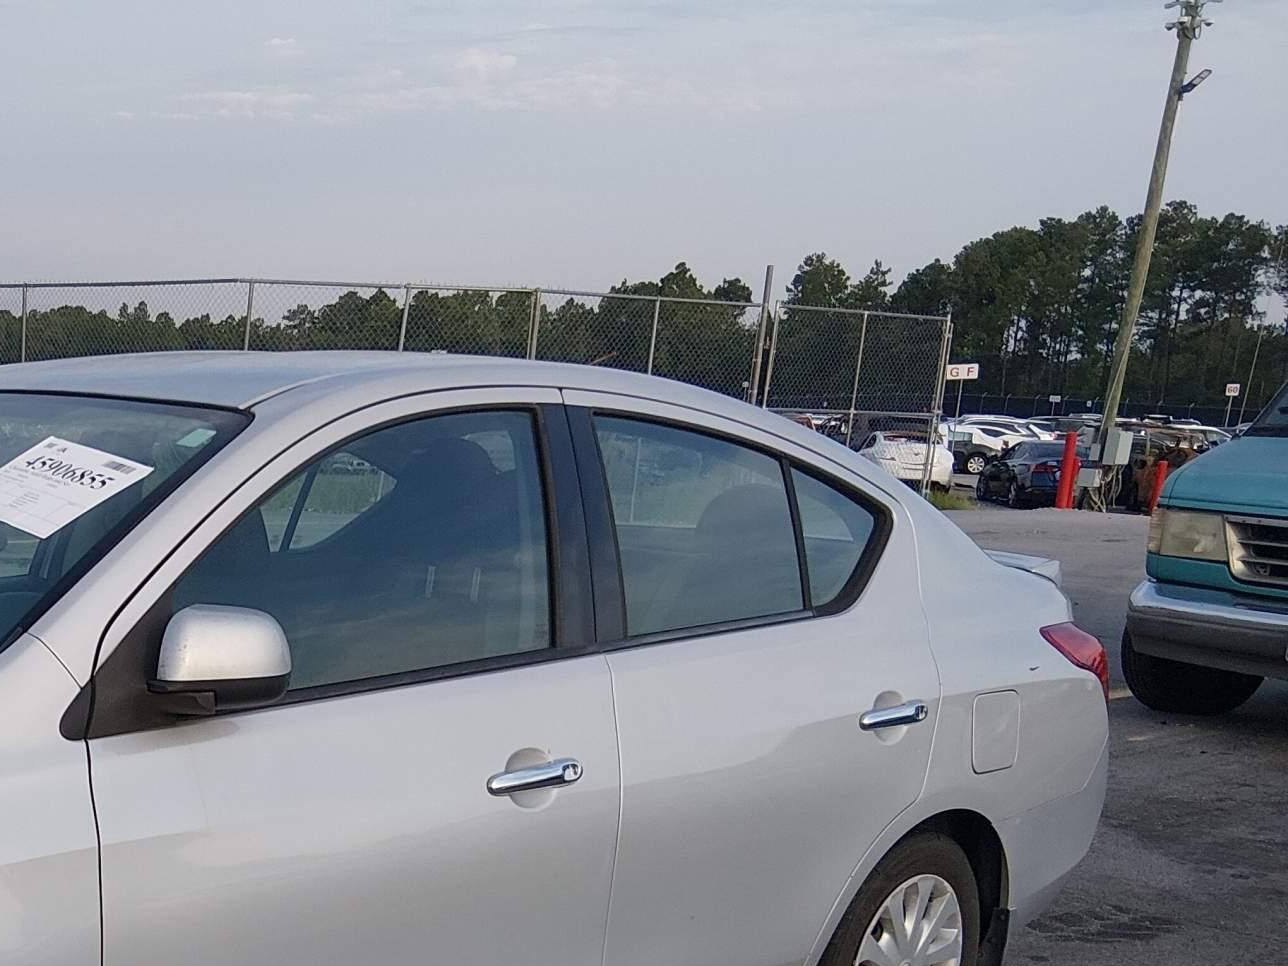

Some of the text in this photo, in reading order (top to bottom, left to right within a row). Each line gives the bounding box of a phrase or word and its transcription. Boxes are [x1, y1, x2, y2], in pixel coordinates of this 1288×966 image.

[950, 366, 974, 377] G F
[24, 455, 115, 490] 45906855
